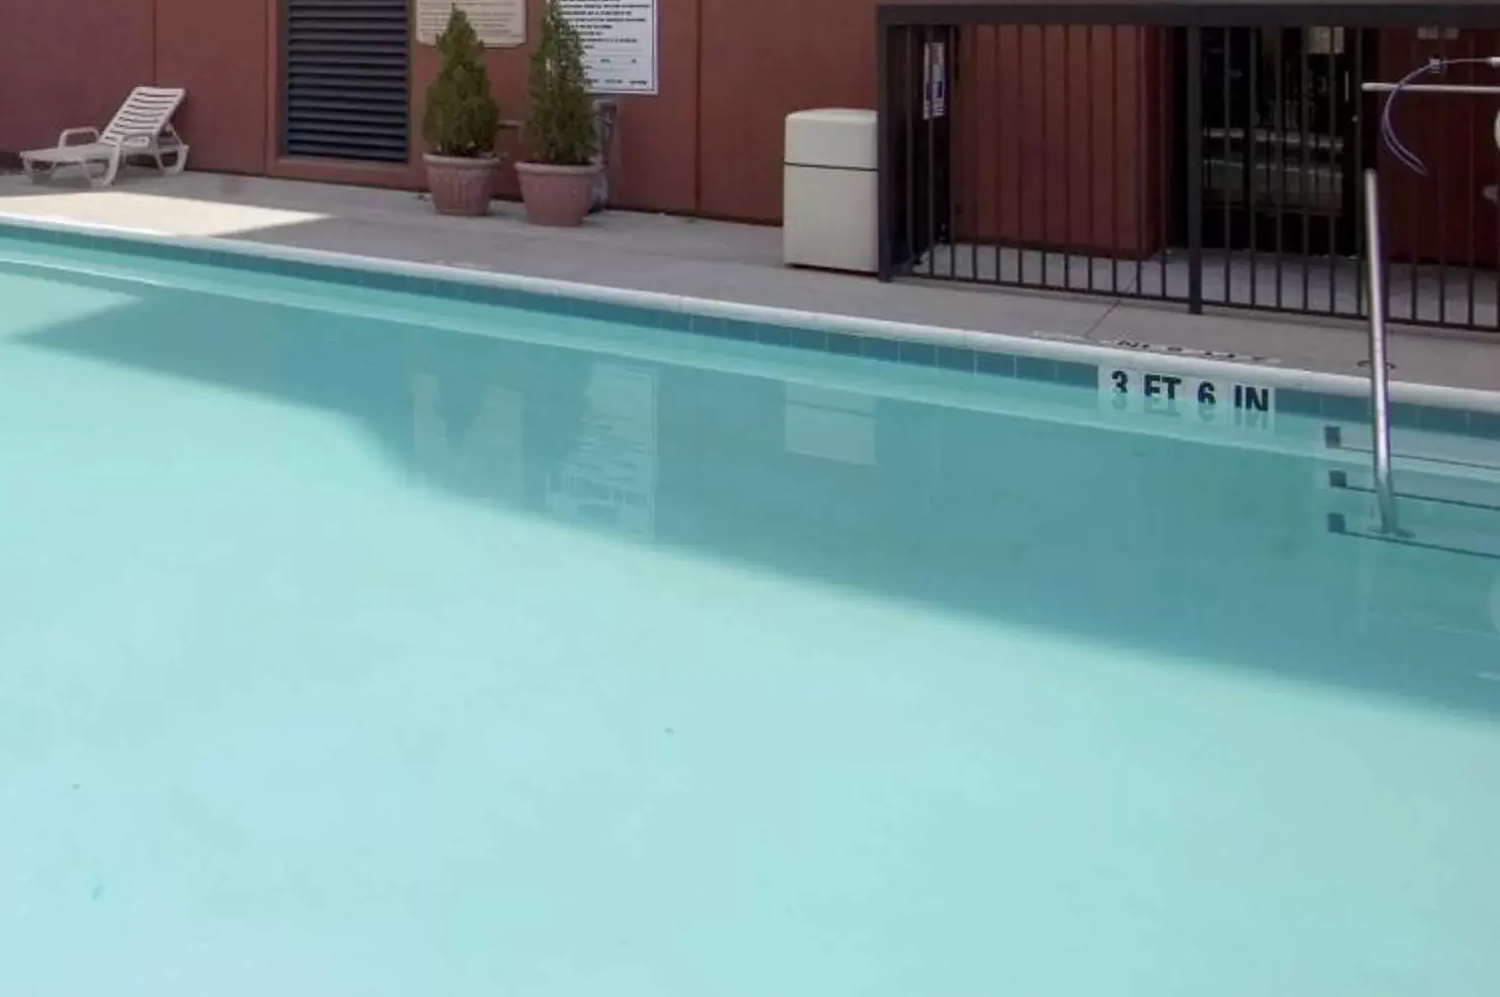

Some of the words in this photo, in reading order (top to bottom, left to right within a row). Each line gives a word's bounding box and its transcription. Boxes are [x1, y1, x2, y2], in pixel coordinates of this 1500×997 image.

[1110, 369, 1129, 395] 3
[1143, 373, 1183, 401] FT
[1196, 380, 1218, 406] 6
[1232, 384, 1270, 412] IN
